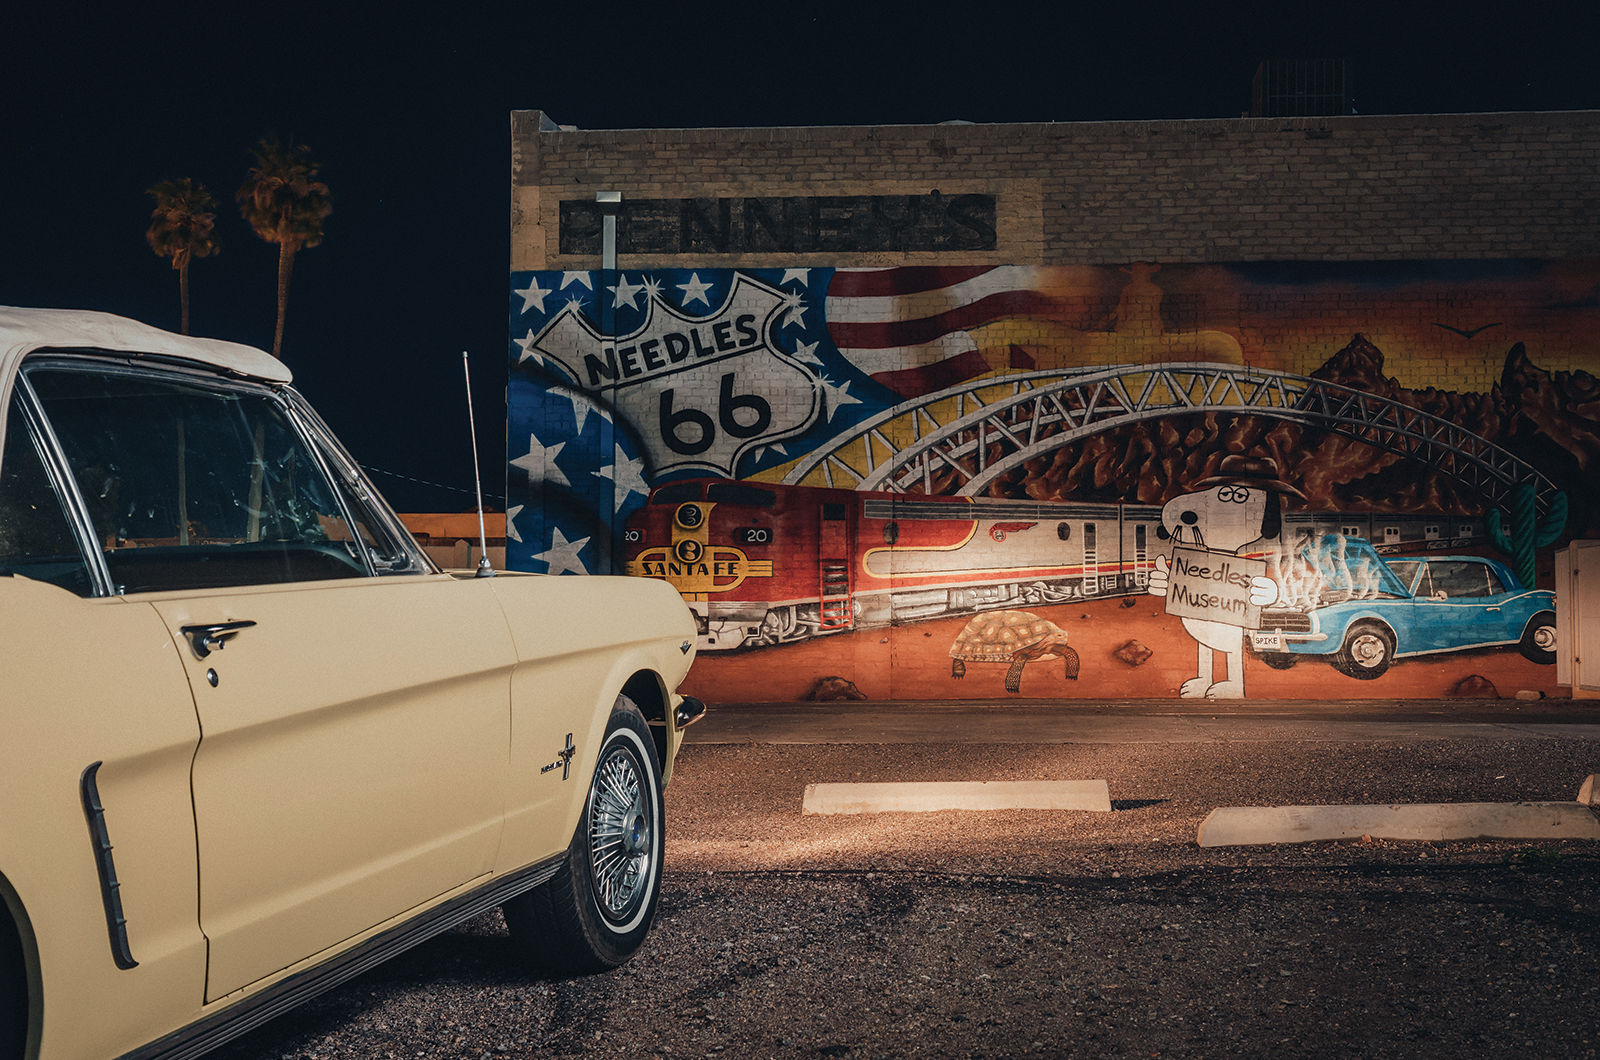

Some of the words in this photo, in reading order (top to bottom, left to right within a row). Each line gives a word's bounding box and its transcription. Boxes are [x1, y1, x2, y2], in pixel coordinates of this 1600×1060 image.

[584, 314, 758, 386] NEEDLES
[659, 372, 772, 456] 66
[624, 530, 639, 542] 20
[747, 529, 768, 543] 20
[642, 562, 709, 576] SANTA
[714, 562, 739, 576] FE
[1175, 556, 1251, 589] Needles
[1171, 583, 1247, 617] Museum
[1255, 637, 1278, 645] SPIKE
